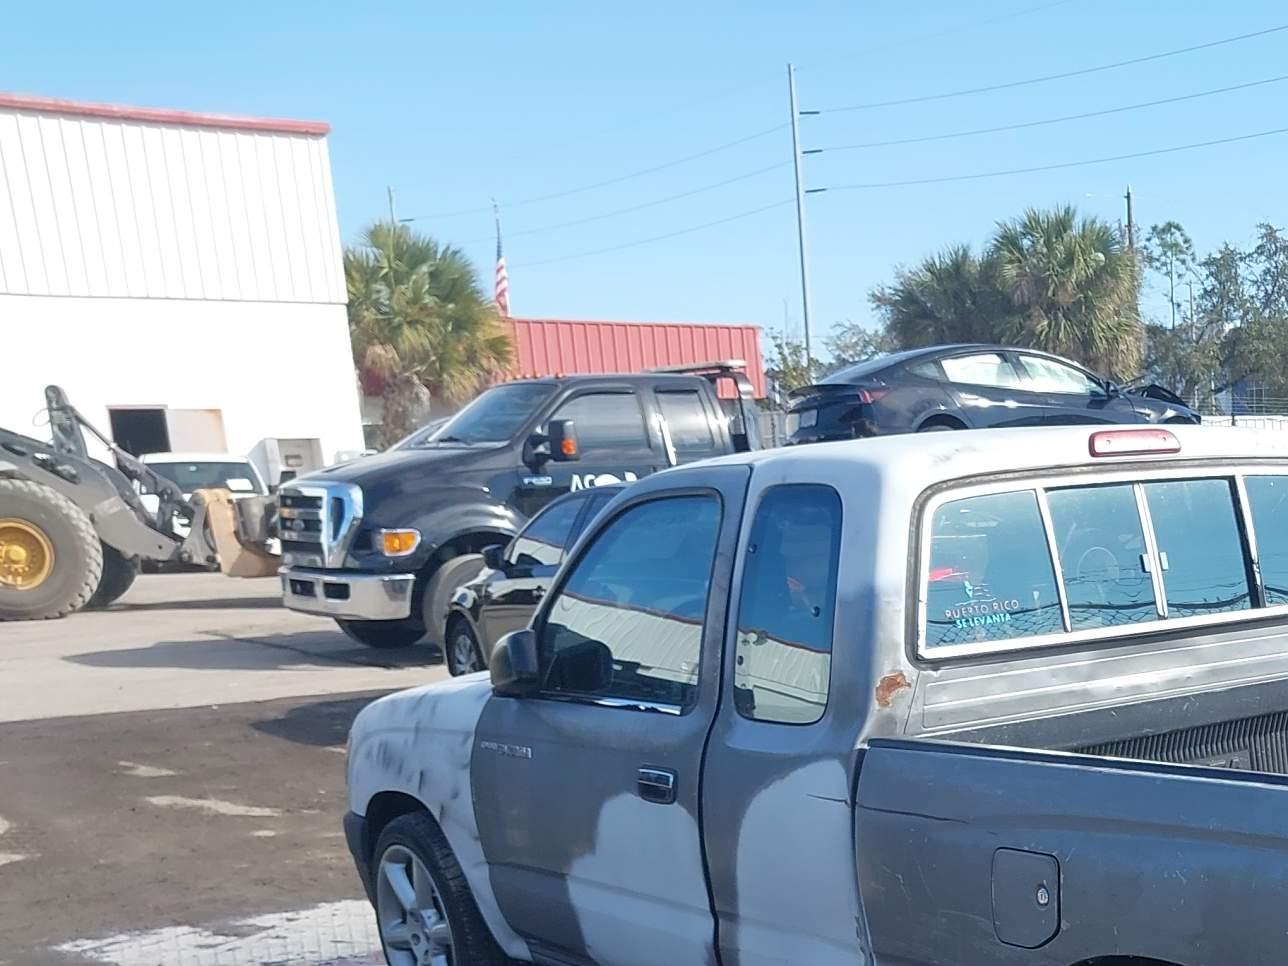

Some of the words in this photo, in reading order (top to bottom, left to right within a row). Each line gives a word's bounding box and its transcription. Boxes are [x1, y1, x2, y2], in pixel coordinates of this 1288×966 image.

[945, 605, 989, 619] PUERTO
[992, 599, 1019, 611] RICO
[955, 618, 968, 629] SE
[968, 613, 1011, 628] LEVANTA
